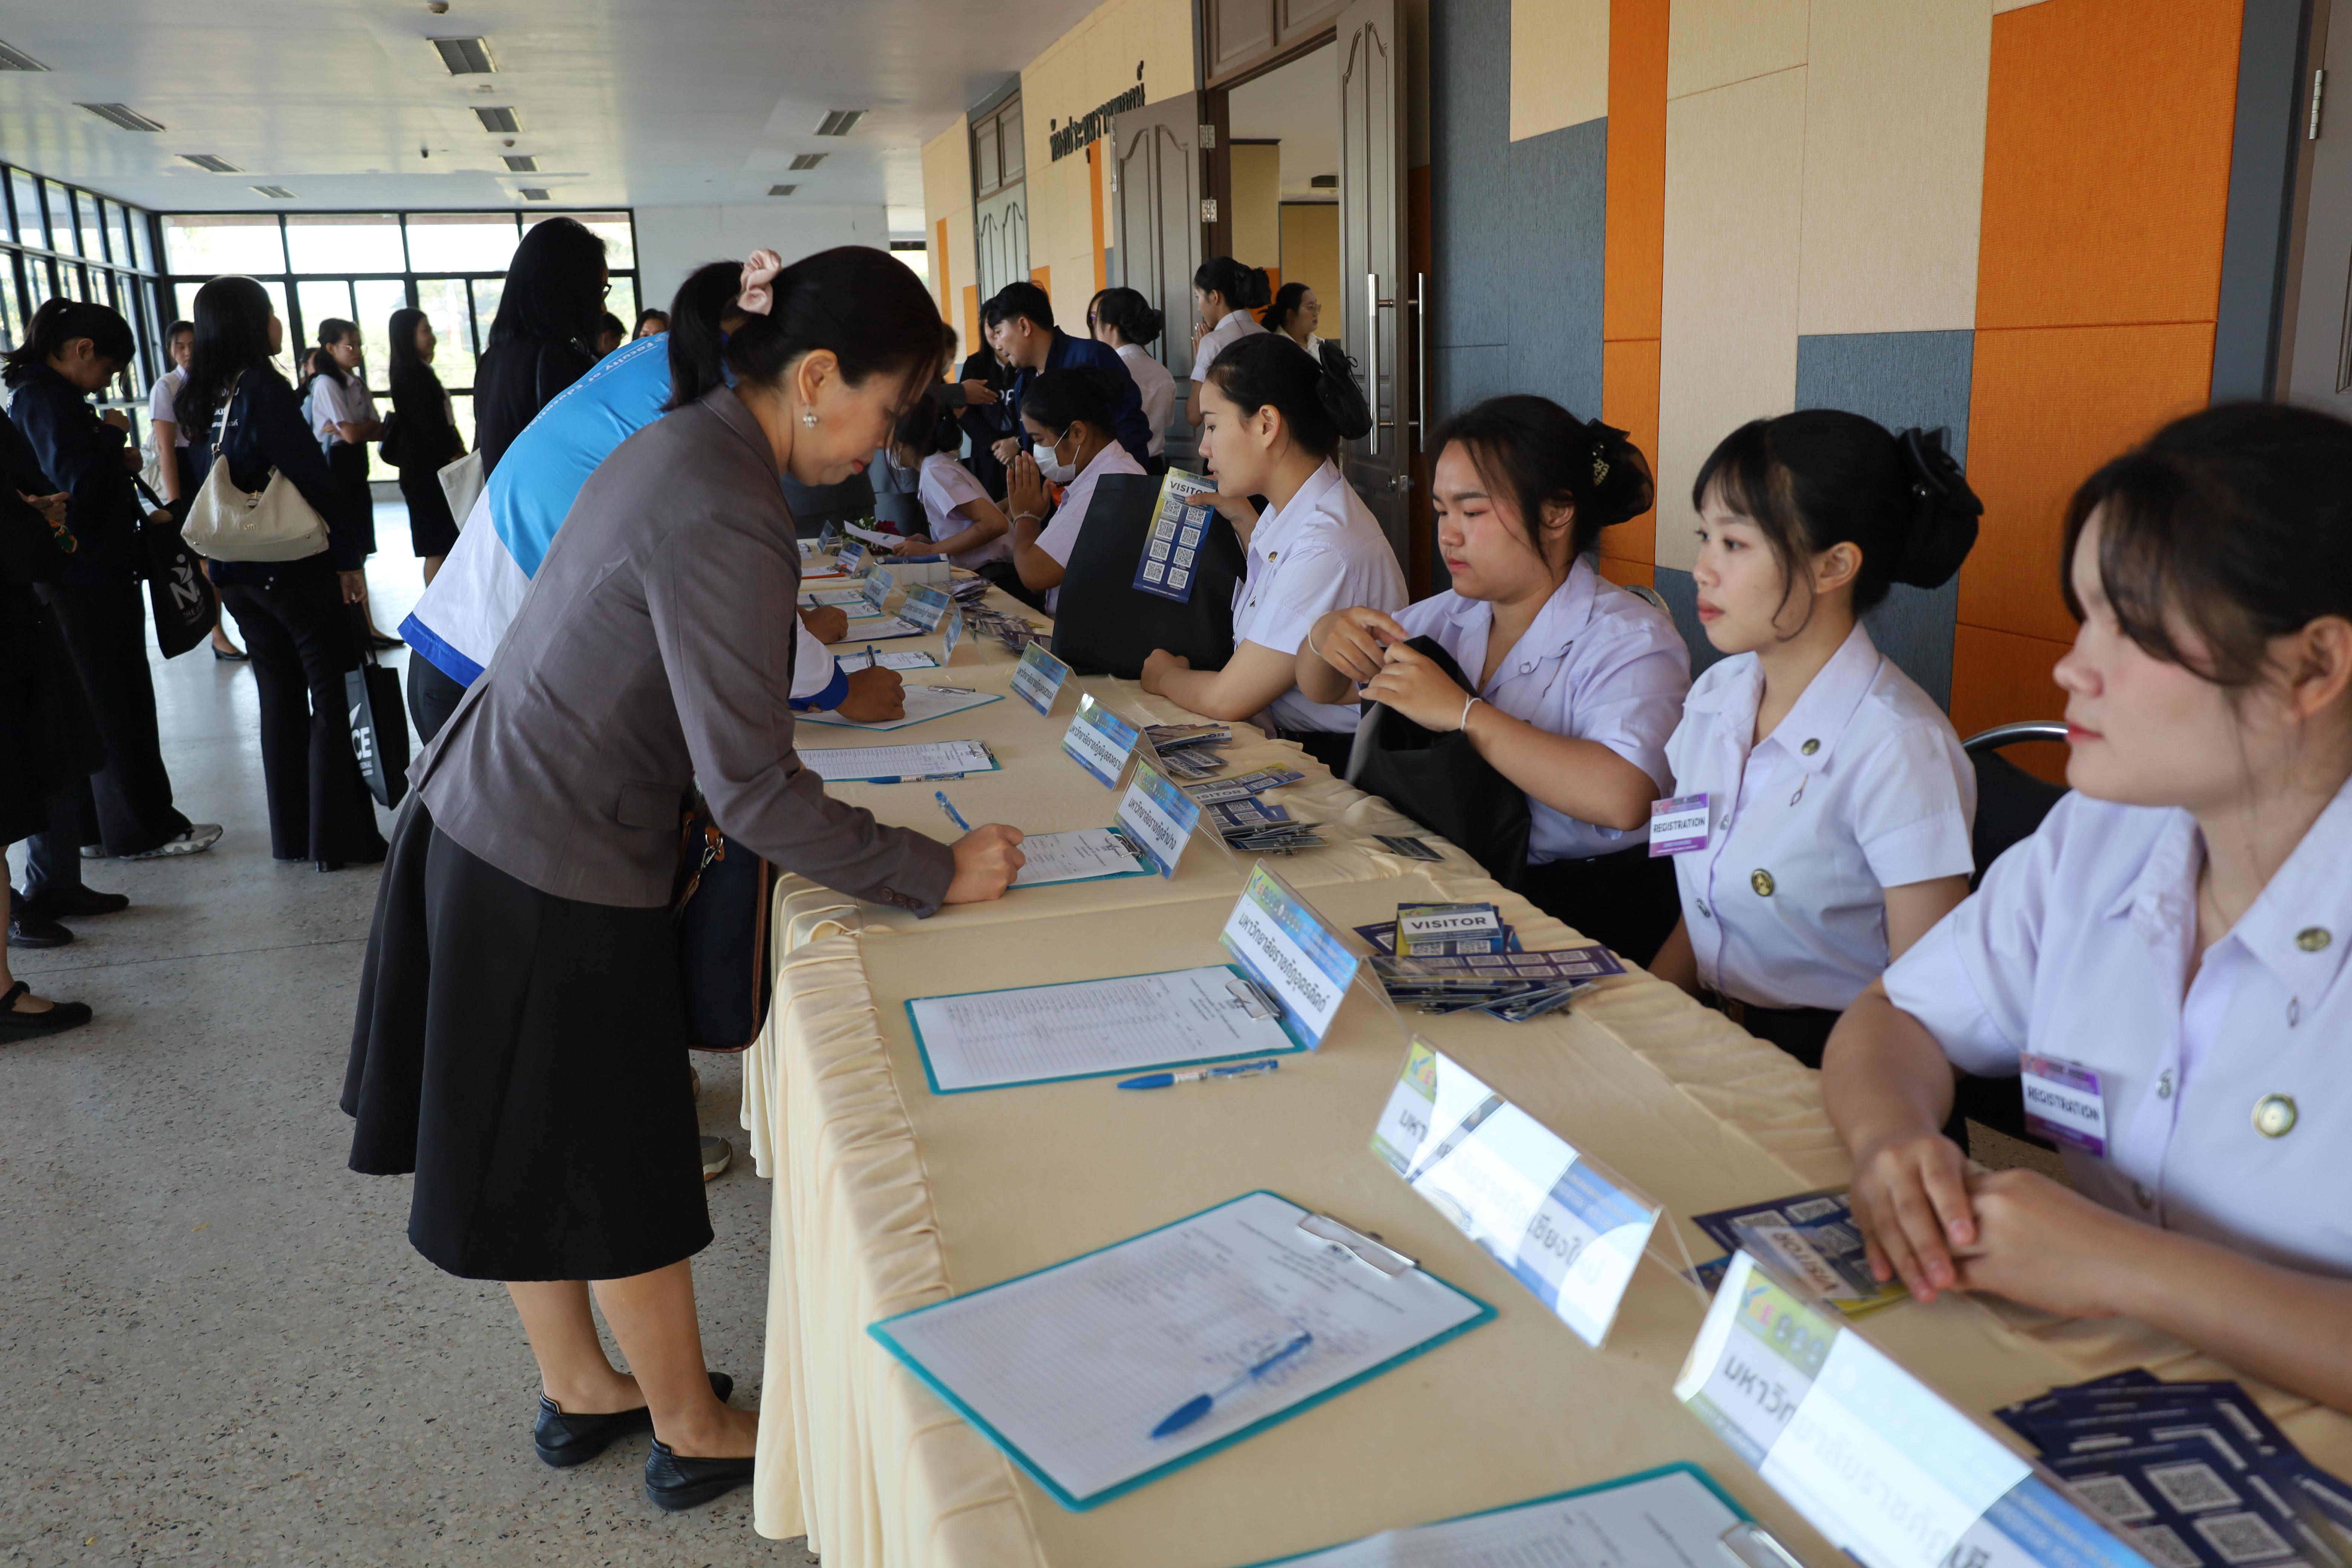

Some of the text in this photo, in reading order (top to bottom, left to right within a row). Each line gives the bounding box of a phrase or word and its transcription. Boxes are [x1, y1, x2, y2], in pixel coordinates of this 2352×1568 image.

[523, 341, 654, 433] Faculty of Education
[1170, 481, 1207, 495] VISITO
[351, 726, 372, 760] CE
[1196, 789, 1241, 800] ISITOR
[1653, 816, 1706, 833] REGISTRATION
[1412, 917, 1486, 929] VISITOR
[1773, 1231, 1838, 1292] VISITOR
